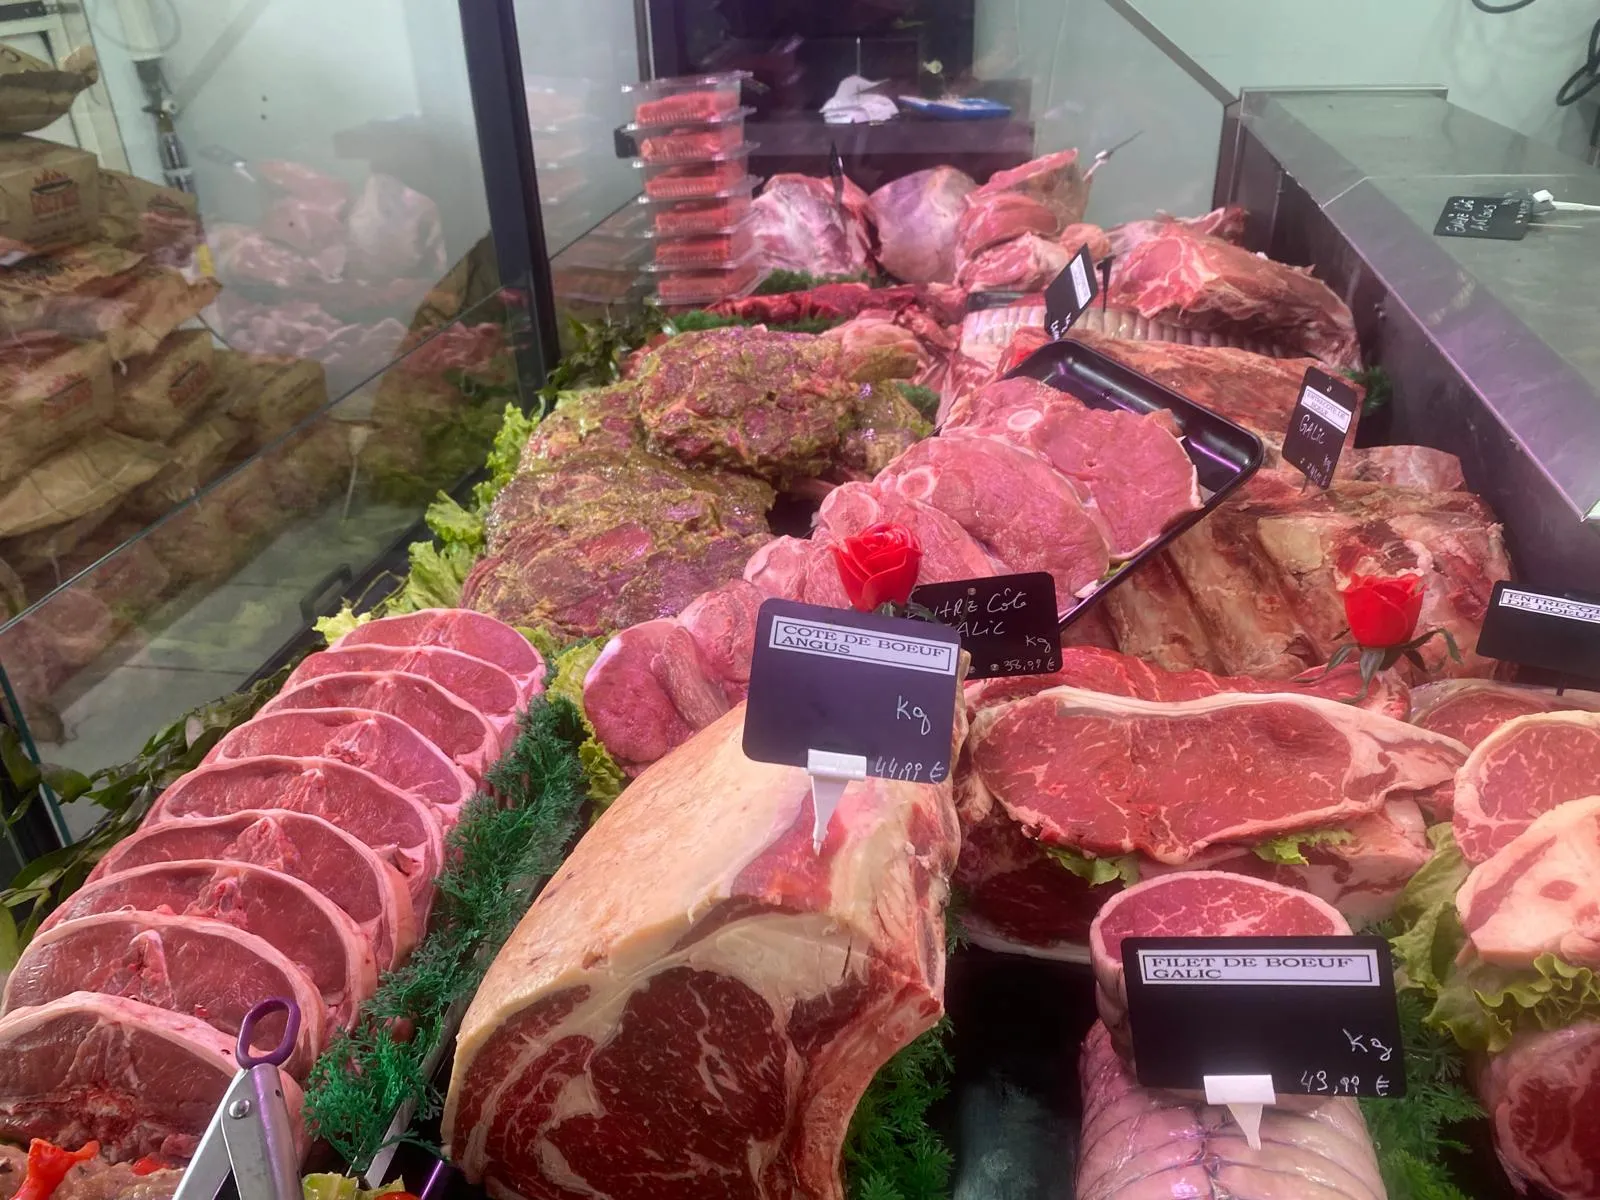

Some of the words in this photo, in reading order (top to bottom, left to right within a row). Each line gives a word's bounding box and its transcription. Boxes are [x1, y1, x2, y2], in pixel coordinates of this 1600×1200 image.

[1506, 599, 1531, 608] DE
[781, 635, 850, 654] ANGUS
[783, 625, 838, 641] COTE
[844, 634, 871, 646] DE
[878, 640, 945, 657] BOEUF
[1024, 634, 1052, 654] Kg
[1046, 656, 1055, 671] €
[896, 695, 931, 736] Kg
[875, 756, 923, 781] 44,99
[929, 761, 945, 784] €
[1152, 957, 1216, 968] FILET
[1223, 957, 1257, 968] DE
[1265, 957, 1354, 968] BOEUF
[1152, 968, 1222, 979] GALIC
[1342, 1028, 1393, 1062] Kg
[1375, 1074, 1390, 1097] €
